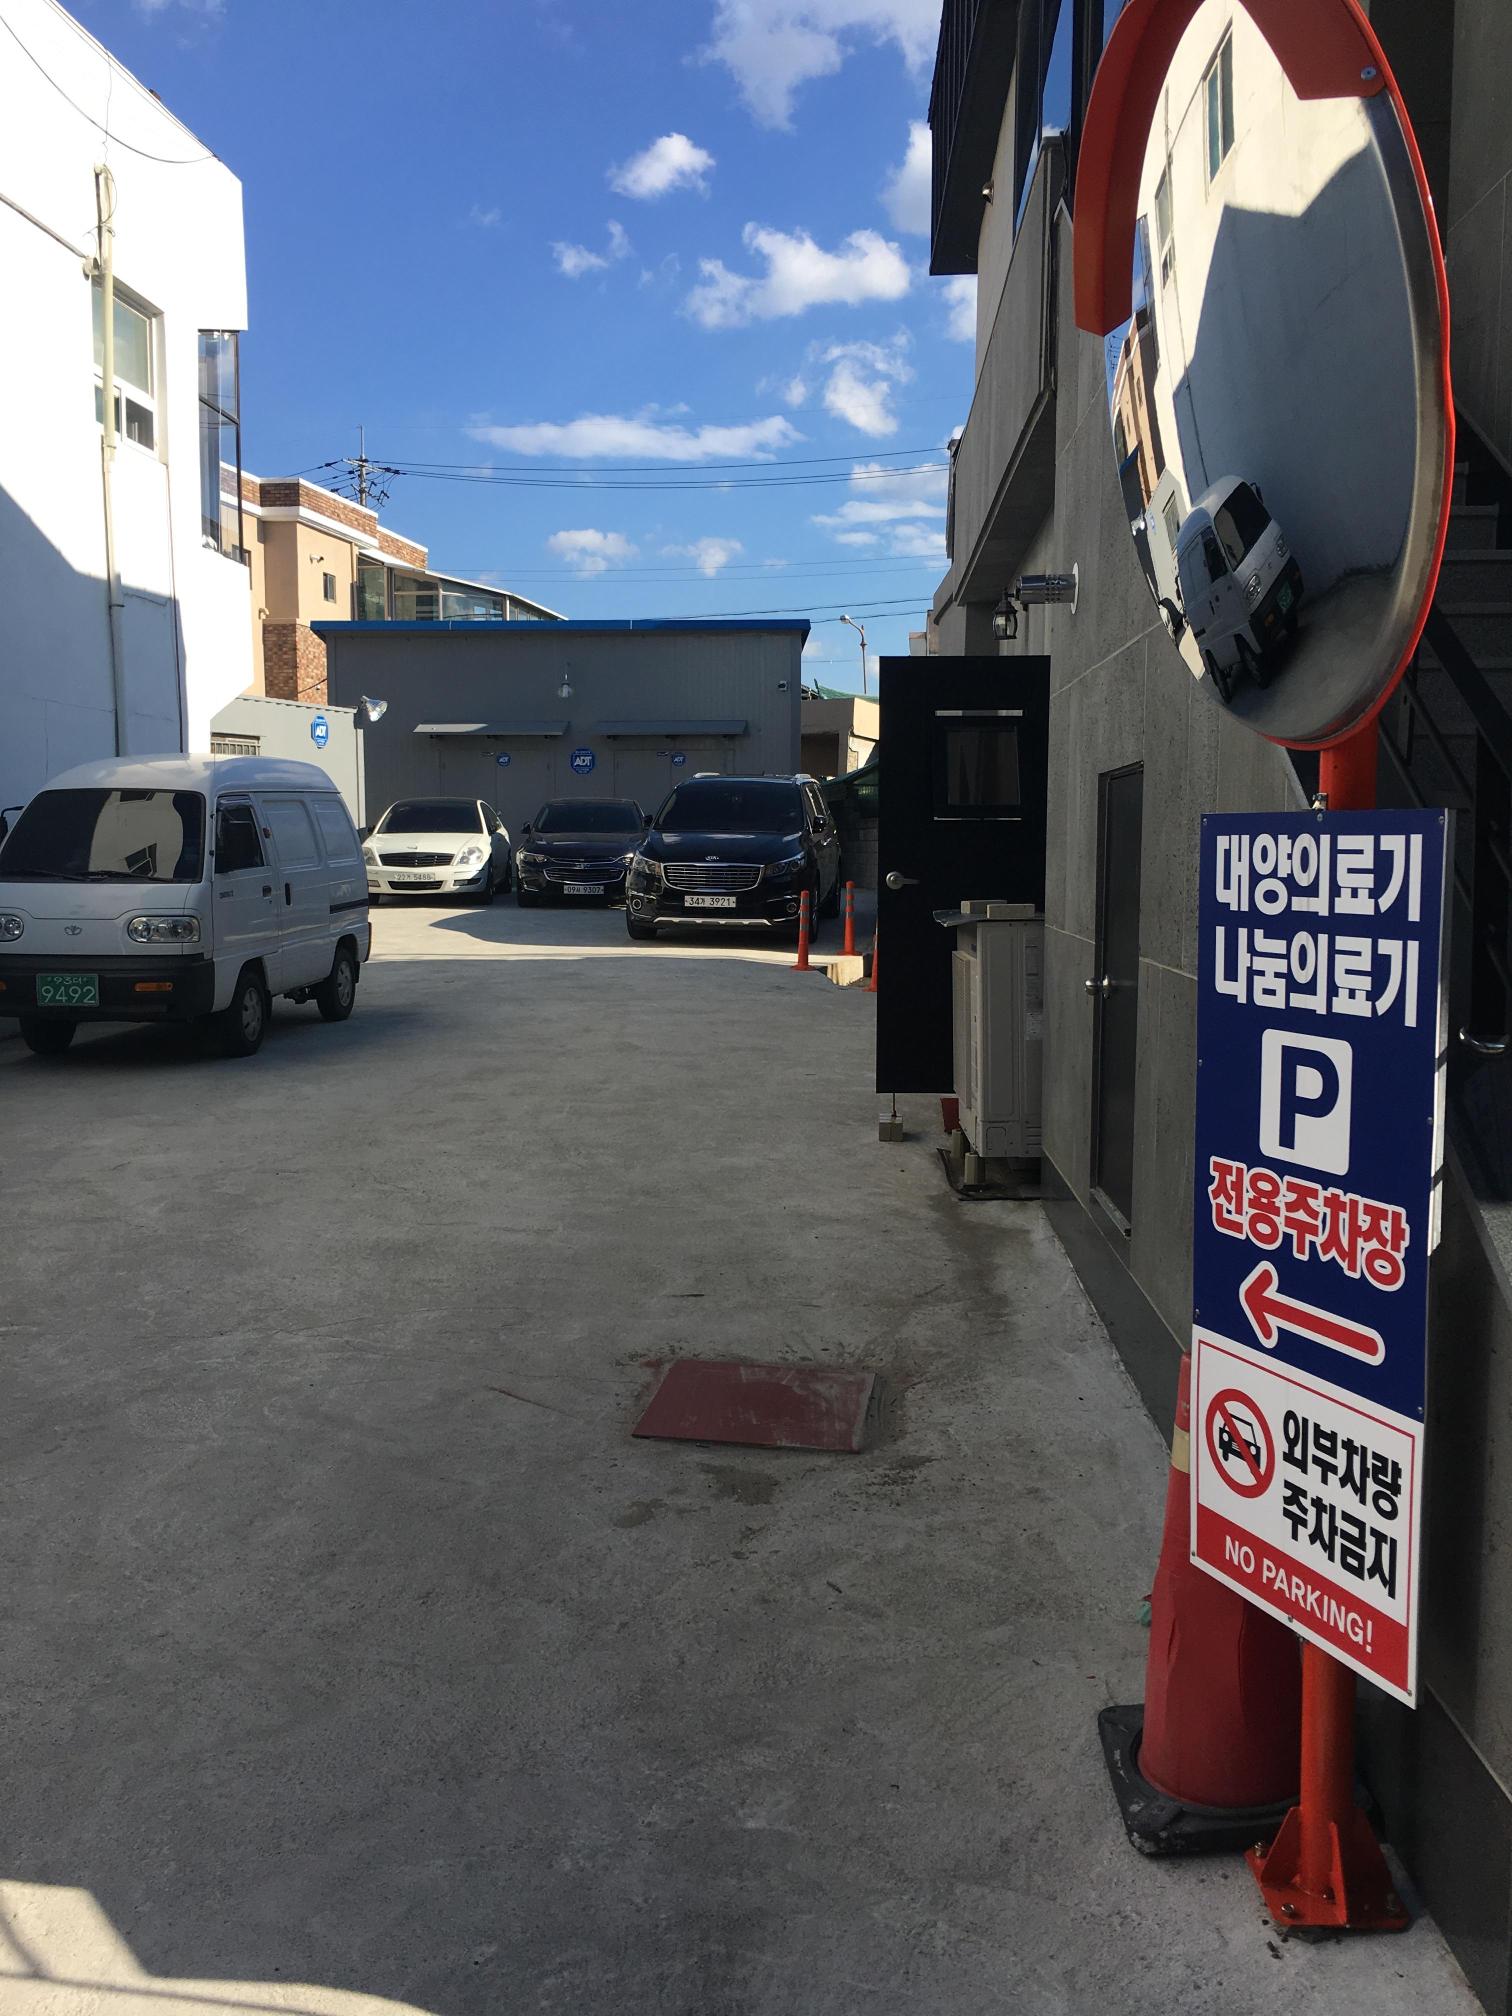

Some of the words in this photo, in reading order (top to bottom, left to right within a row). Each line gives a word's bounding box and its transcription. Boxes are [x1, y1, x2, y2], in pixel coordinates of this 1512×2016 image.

[574, 756, 593, 766] ADT
[709, 897, 731, 907] 3921
[1215, 833, 1423, 922] 대양의료기
[41, 985, 97, 1003] 9492
[1214, 926, 1420, 1028] 나눔의료기
[1276, 1041, 1342, 1153] P
[1208, 1156, 1410, 1292] 전용주차장
[1282, 1409, 1402, 1521] 외부차량
[1282, 1478, 1398, 1600] 주차금지
[1224, 1534, 1256, 1575] NO
[1262, 1558, 1374, 1654] PARKING!
